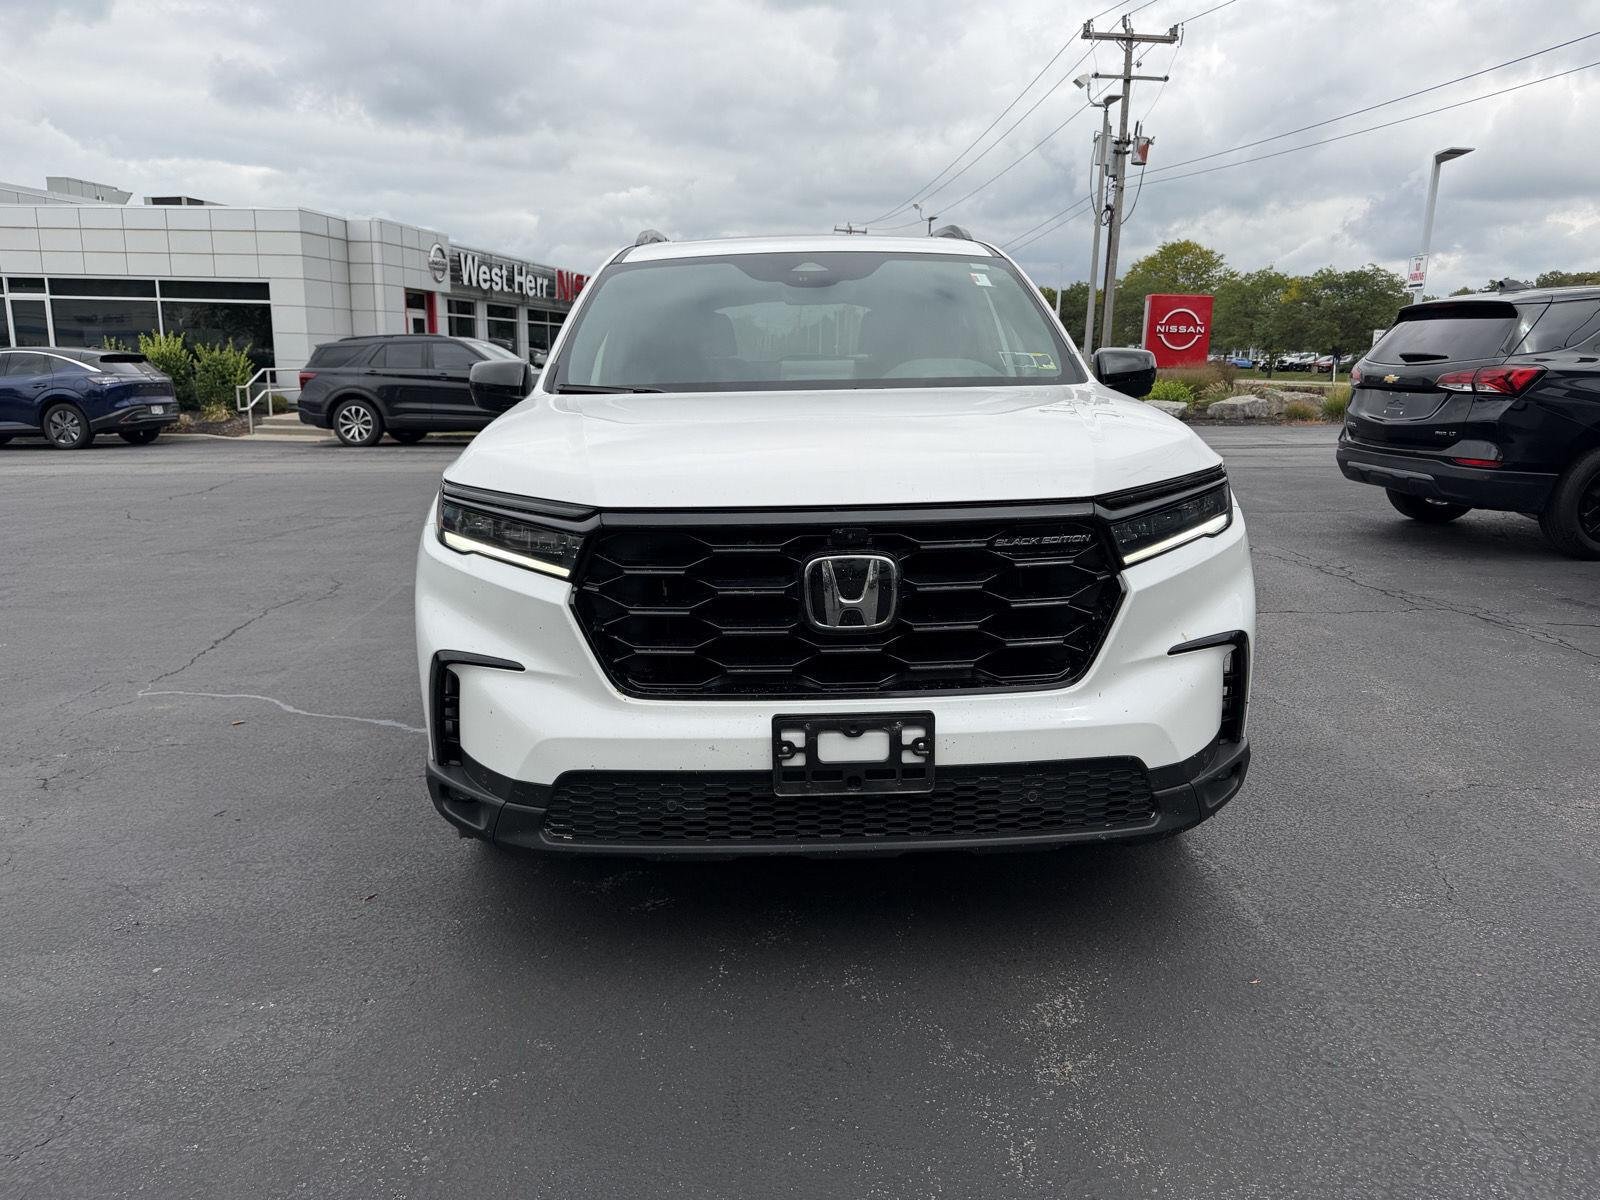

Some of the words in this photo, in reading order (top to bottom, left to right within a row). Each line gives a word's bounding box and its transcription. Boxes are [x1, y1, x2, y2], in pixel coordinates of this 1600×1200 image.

[459, 252, 511, 292] West
[513, 264, 549, 298] Herr
[1156, 325, 1205, 333] NISSAN
[994, 537, 1040, 547] BLACK
[1041, 534, 1092, 544] EDITION
